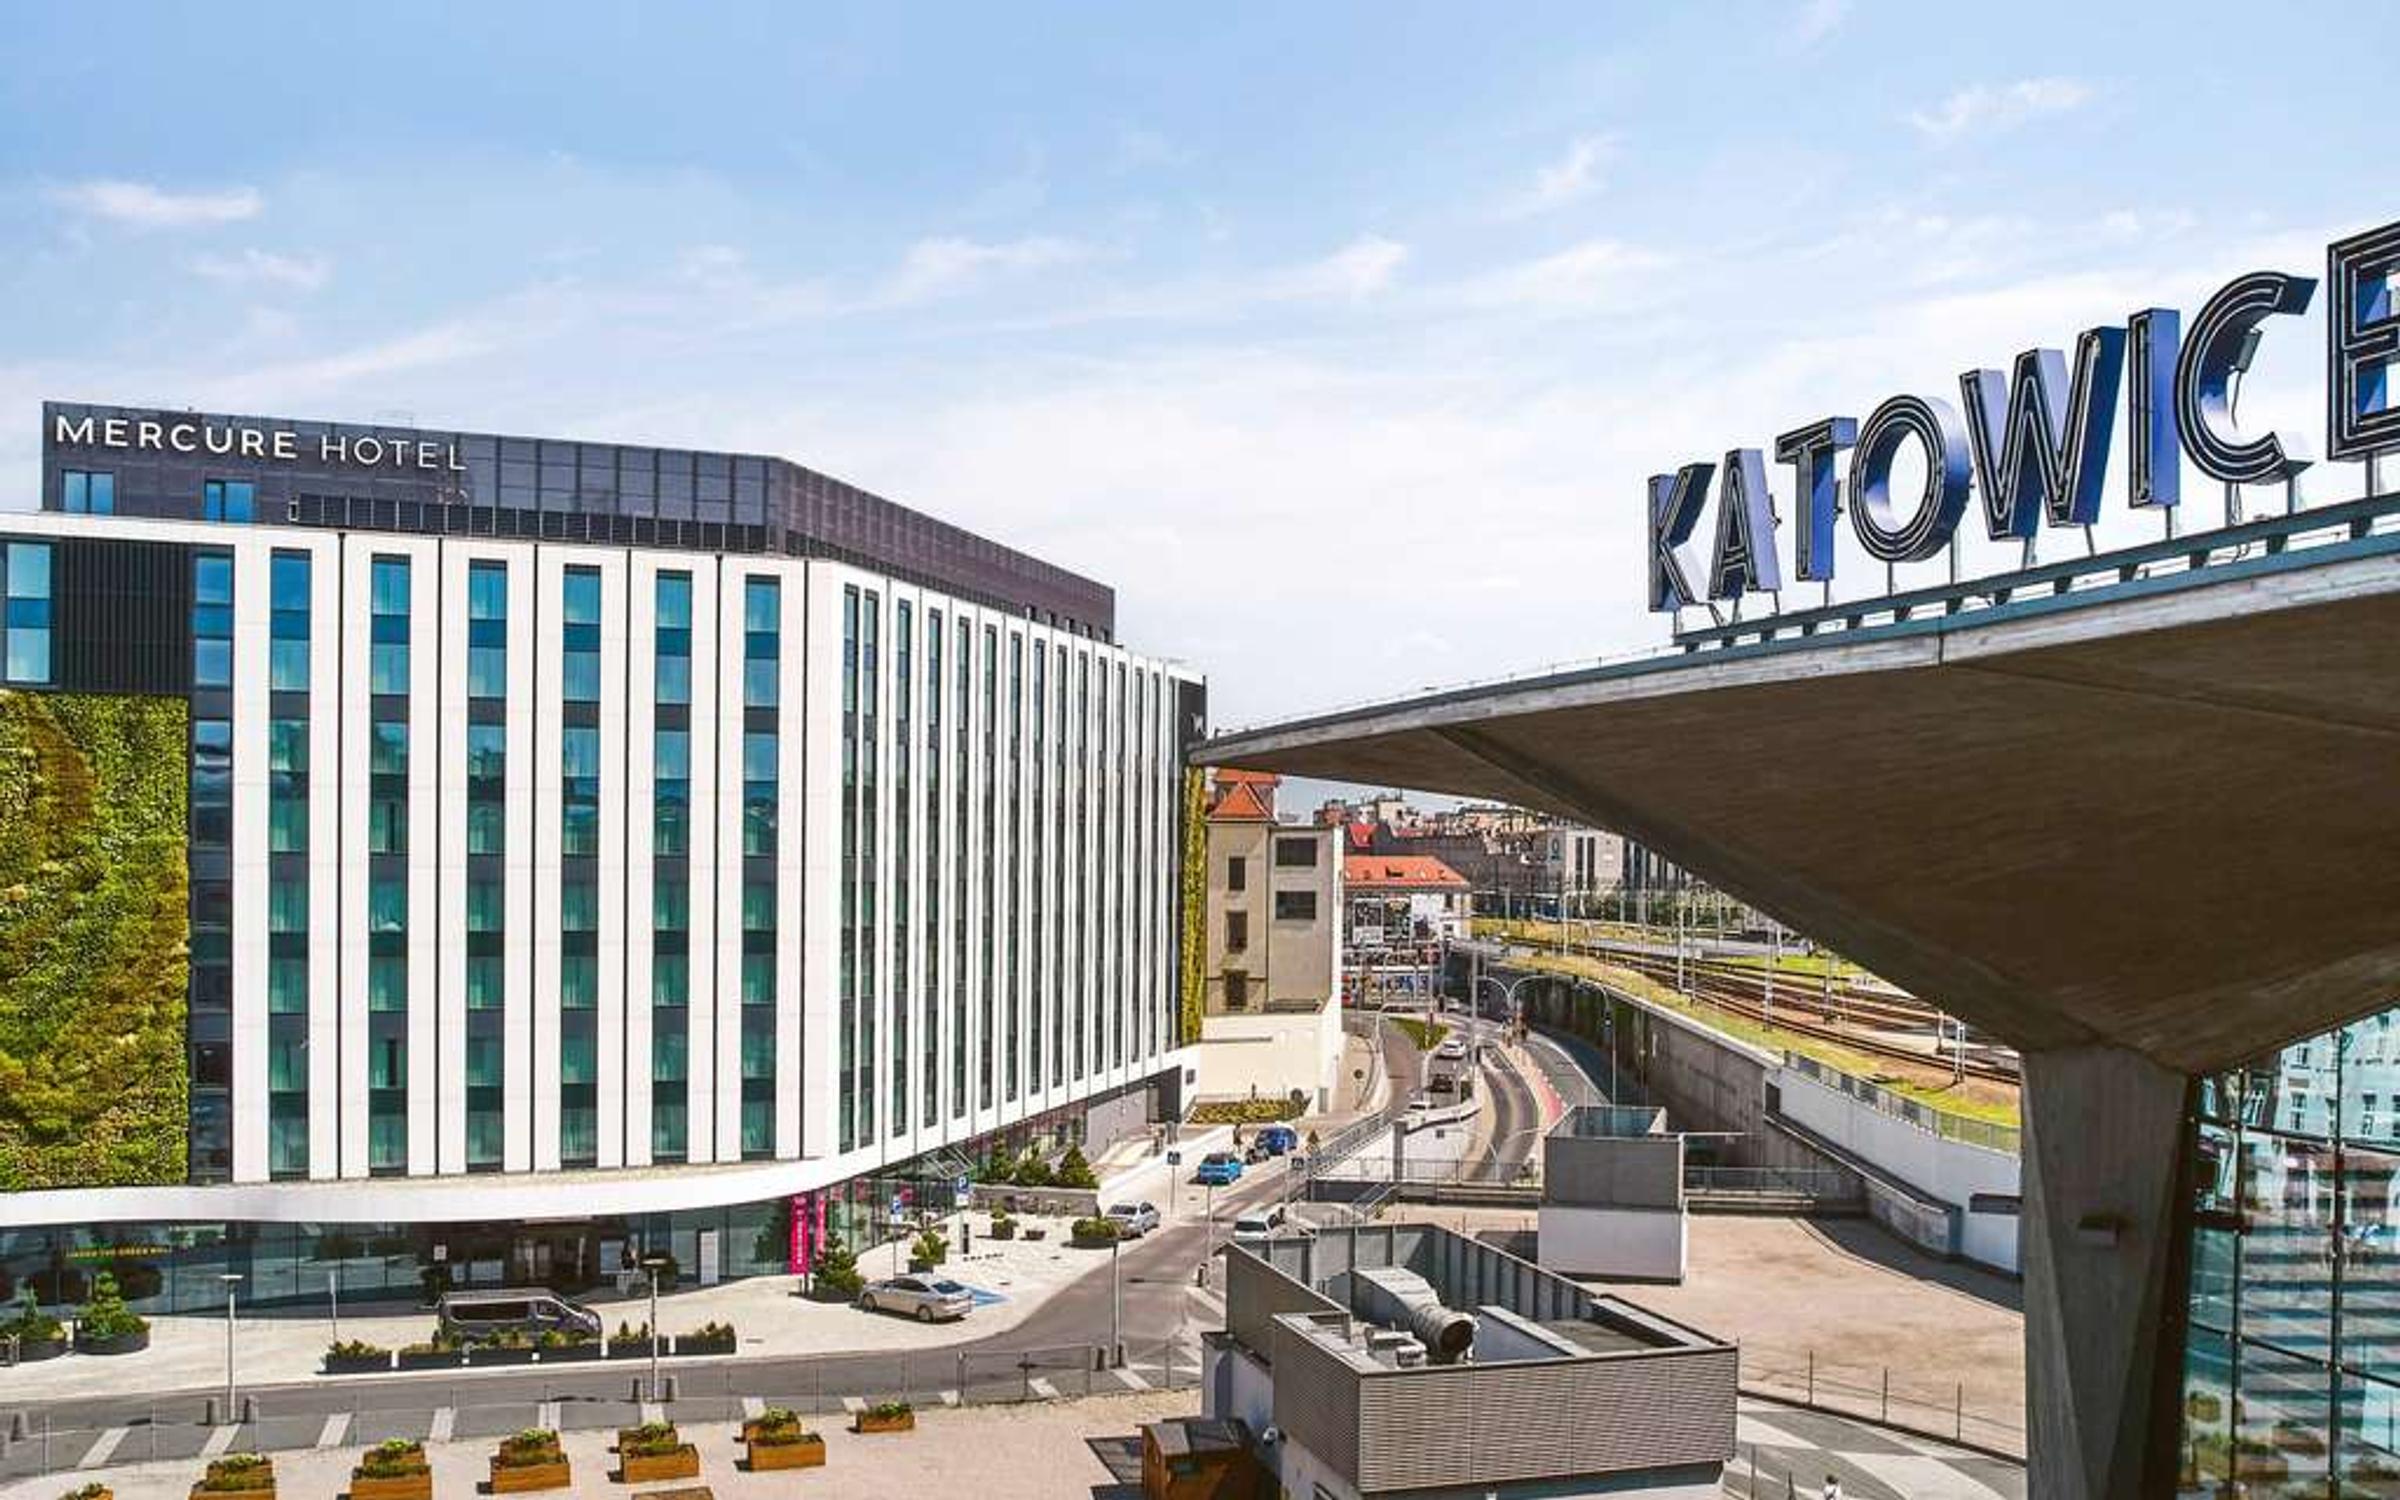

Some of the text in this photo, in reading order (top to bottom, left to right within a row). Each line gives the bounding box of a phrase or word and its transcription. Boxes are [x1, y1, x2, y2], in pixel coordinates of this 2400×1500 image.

[56, 415, 468, 471] MERCURE HOTEL
[1648, 220, 2400, 613] KATOWICE
